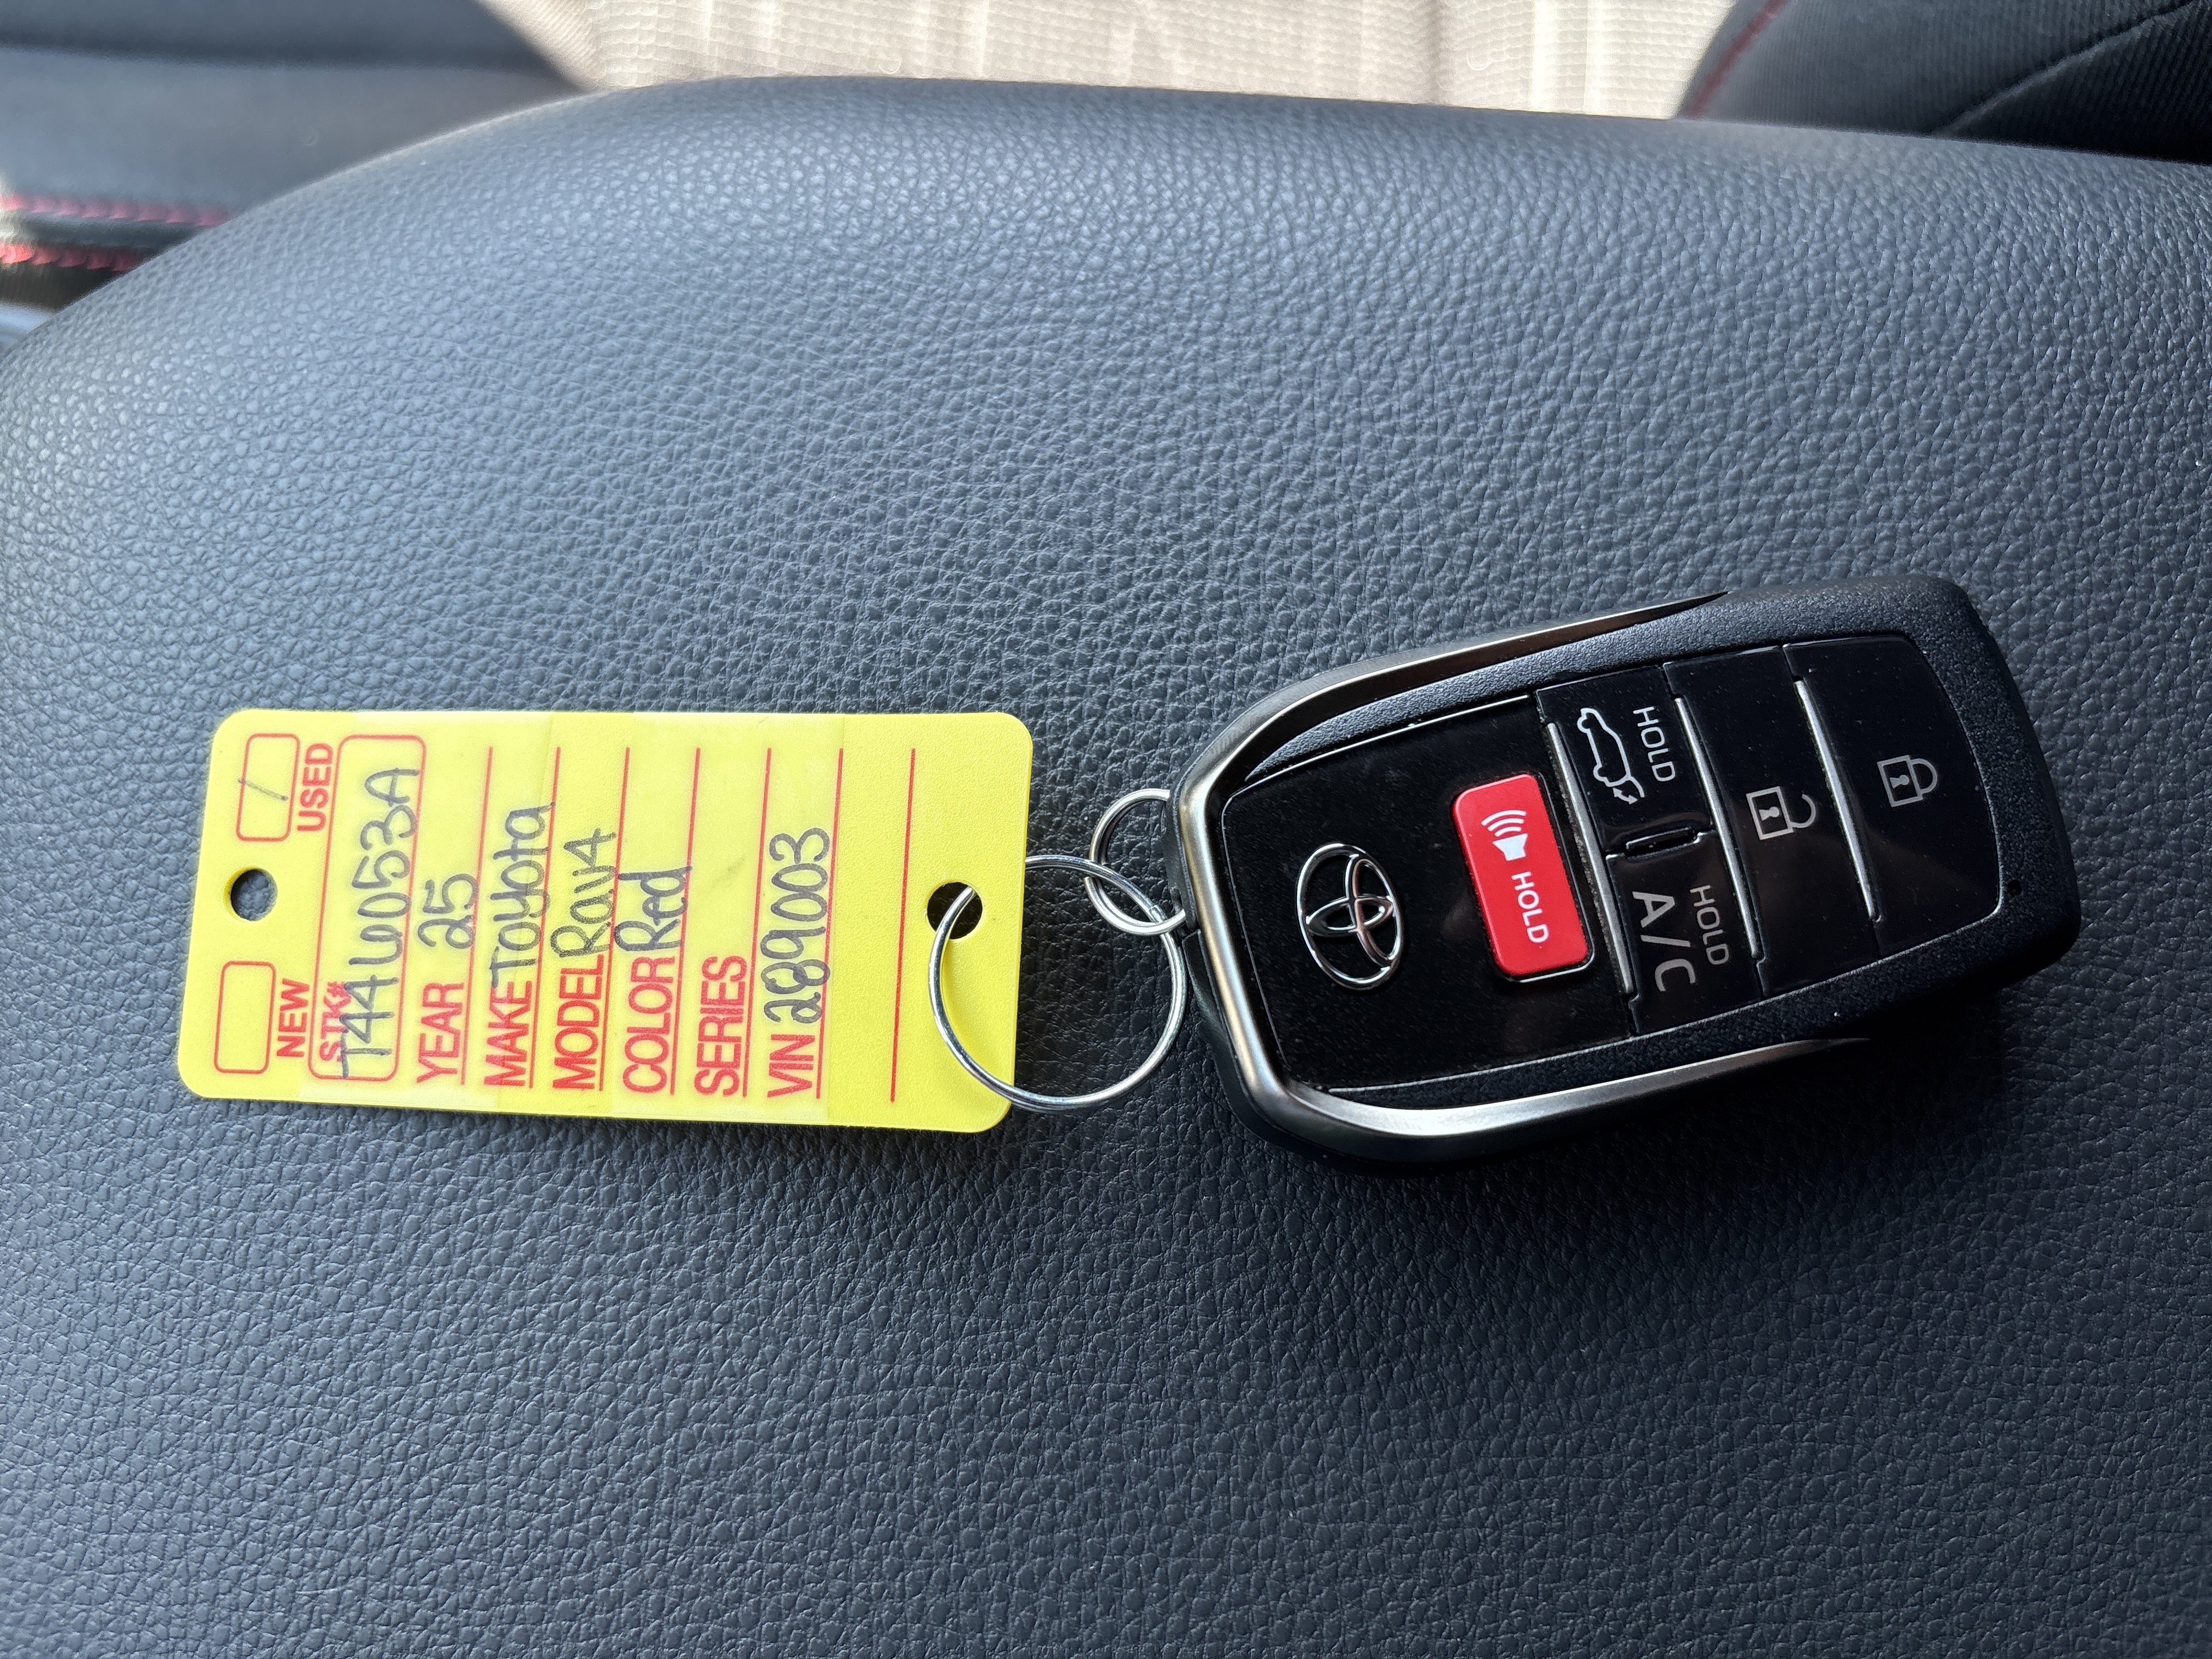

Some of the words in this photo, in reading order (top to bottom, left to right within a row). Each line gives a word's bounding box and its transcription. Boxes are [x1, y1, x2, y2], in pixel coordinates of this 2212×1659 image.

[297, 743, 333, 831] USED
[1633, 707, 1675, 781] HOLD
[339, 768, 420, 1079] T446053A
[417, 873, 478, 949] 25
[613, 866, 692, 951] Red
[760, 827, 830, 1024] 289003
[1511, 871, 1549, 943] HOLD
[1632, 891, 1696, 992] A/C
[1690, 885, 1729, 965] HOLD
[276, 979, 310, 1057] NEW
[320, 981, 351, 1062] STK#
[416, 982, 464, 1083] YEAR
[484, 981, 532, 1086] MAKE
[552, 955, 603, 1091] MODEL
[623, 956, 675, 1093] COLOR
[694, 956, 747, 1096] SERIES
[768, 1034, 815, 1098] VIN
